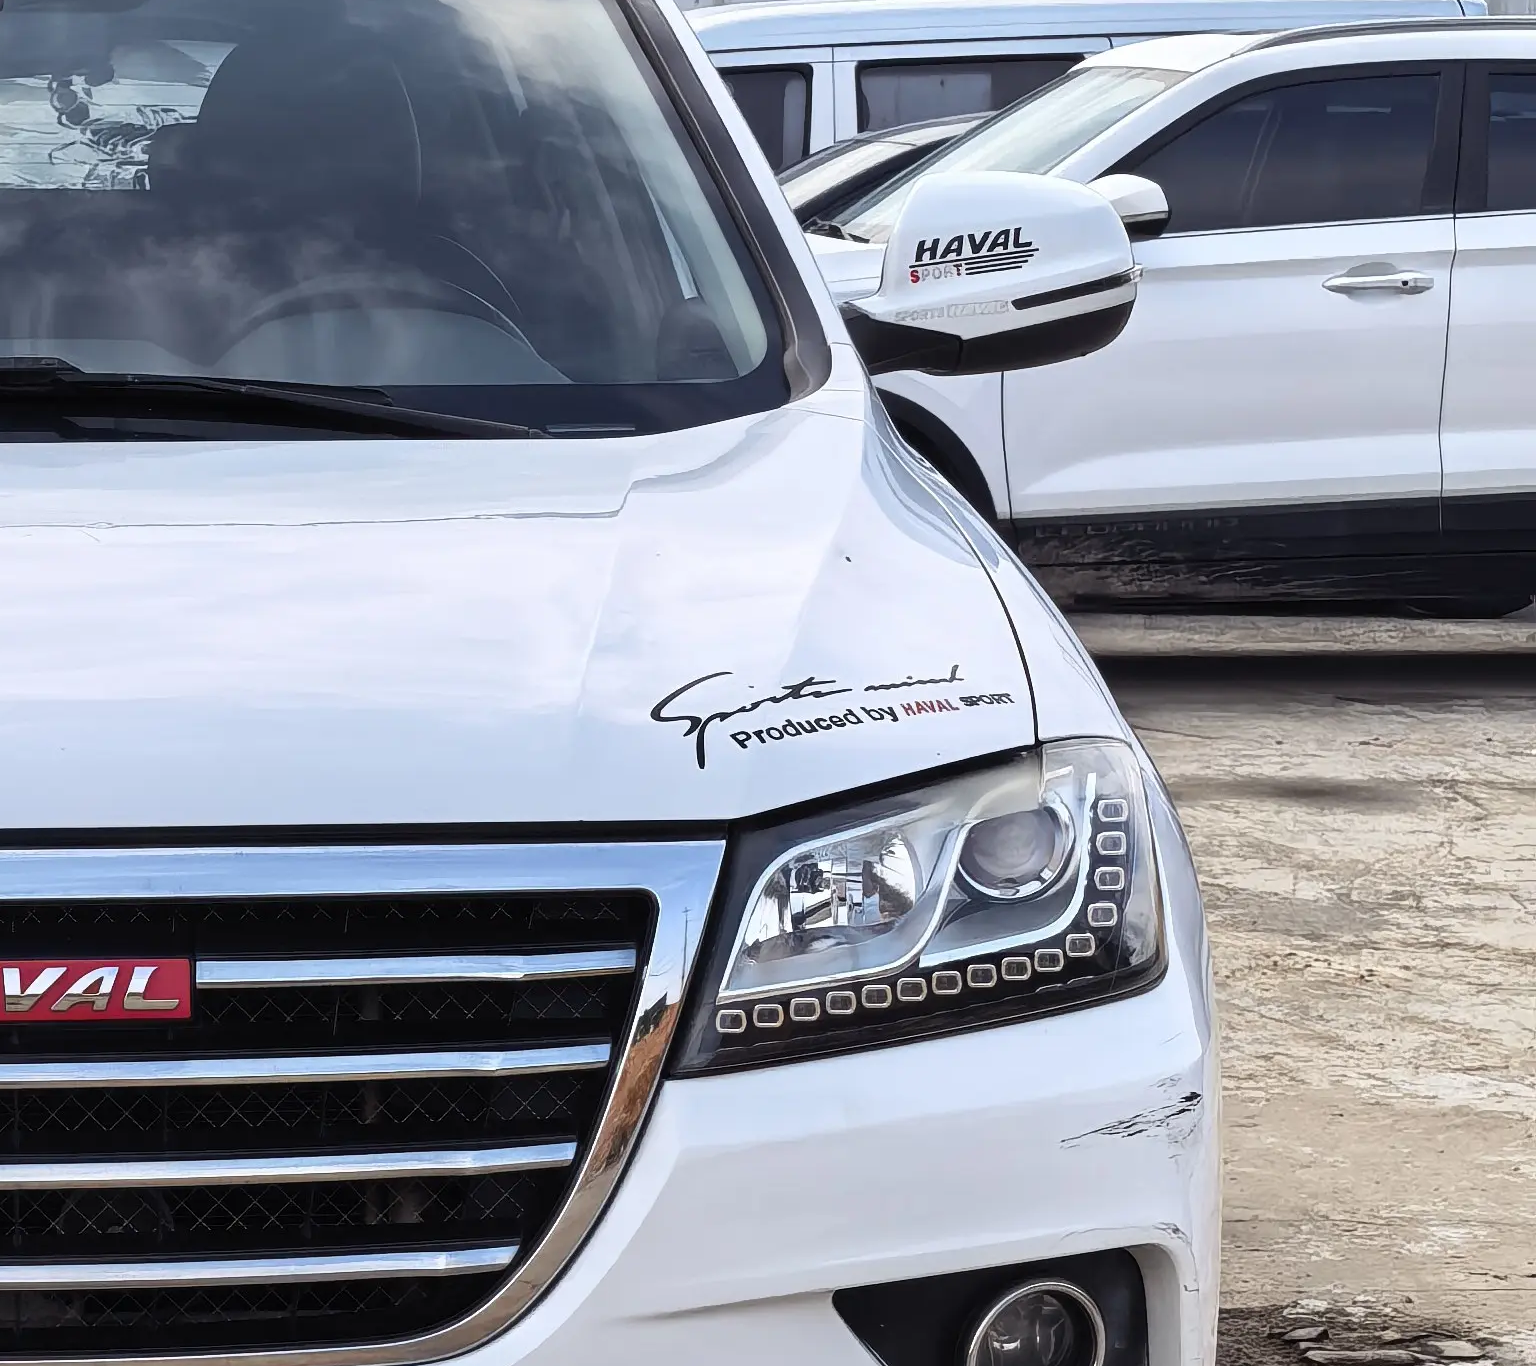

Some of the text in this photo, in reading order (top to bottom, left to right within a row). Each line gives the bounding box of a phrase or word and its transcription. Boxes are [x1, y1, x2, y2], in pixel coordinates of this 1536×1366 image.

[914, 227, 1032, 263] HAVAL
[910, 263, 963, 284] SPORT
[730, 692, 1015, 749] Produced by HAVAL SPORT
